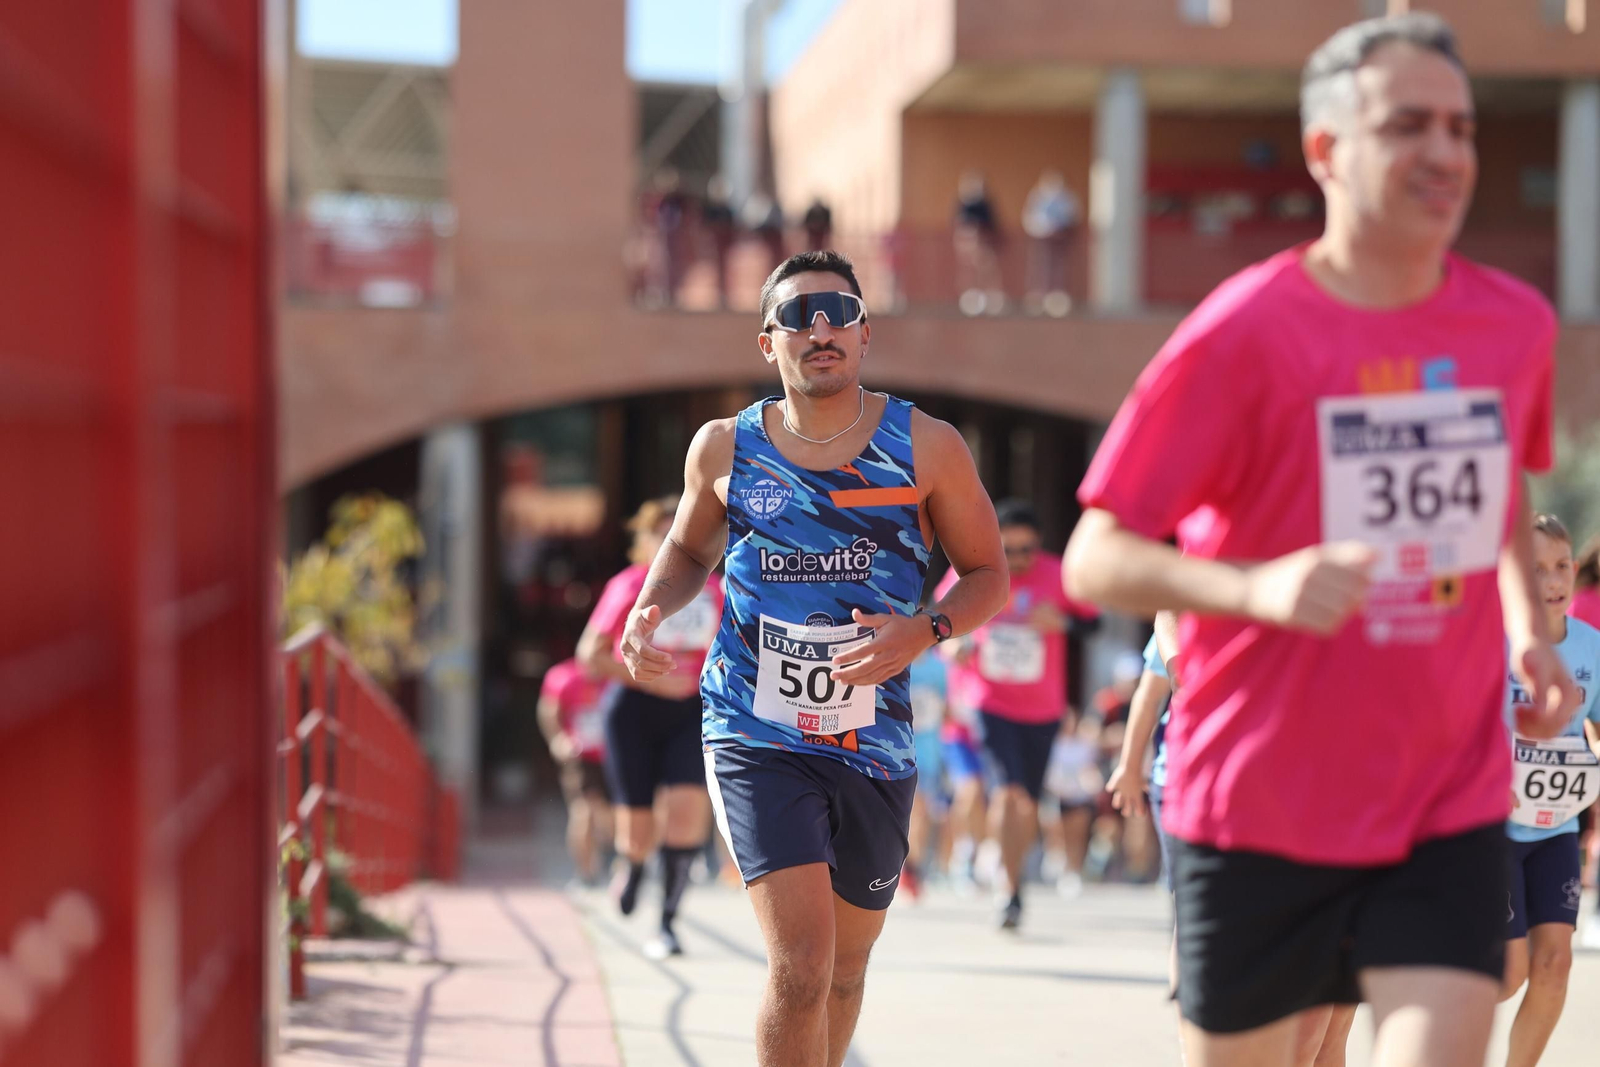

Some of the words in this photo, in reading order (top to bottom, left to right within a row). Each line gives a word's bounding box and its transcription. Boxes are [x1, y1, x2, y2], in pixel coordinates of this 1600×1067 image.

[1364, 457, 1482, 527] 364
[765, 633, 819, 659] UMA
[798, 715, 819, 728] WE
[821, 724, 839, 732] RUN
[1517, 748, 1560, 765] UMA
[1524, 769, 1587, 802] 694
